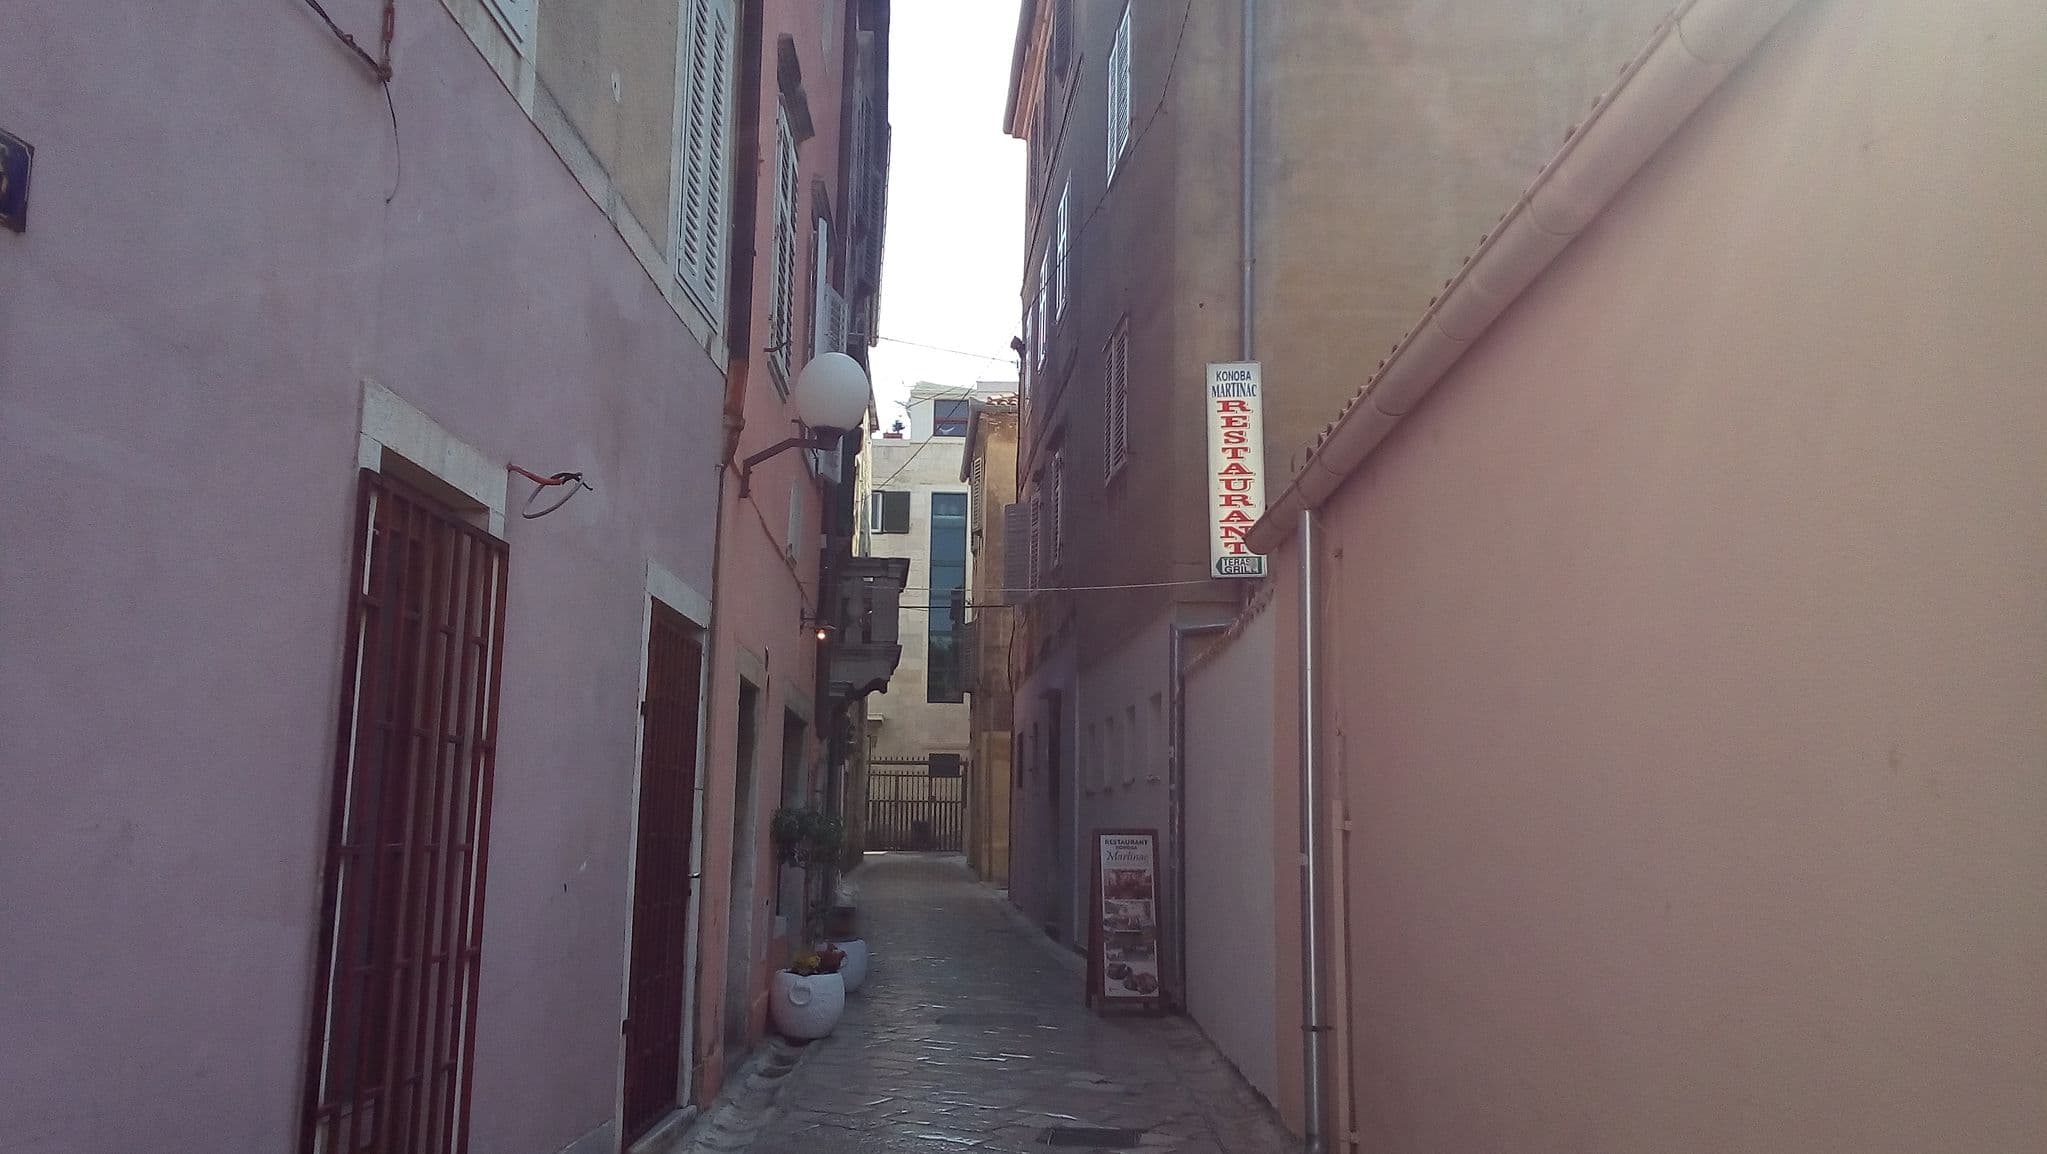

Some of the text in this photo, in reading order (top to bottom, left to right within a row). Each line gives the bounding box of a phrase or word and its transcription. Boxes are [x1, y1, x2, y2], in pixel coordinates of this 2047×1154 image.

[1216, 370, 1252, 381] KONOBA
[1211, 382, 1257, 398] MARTINAC
[1217, 400, 1255, 555] RESTAURANT
[1223, 558, 1253, 566] TERAS
